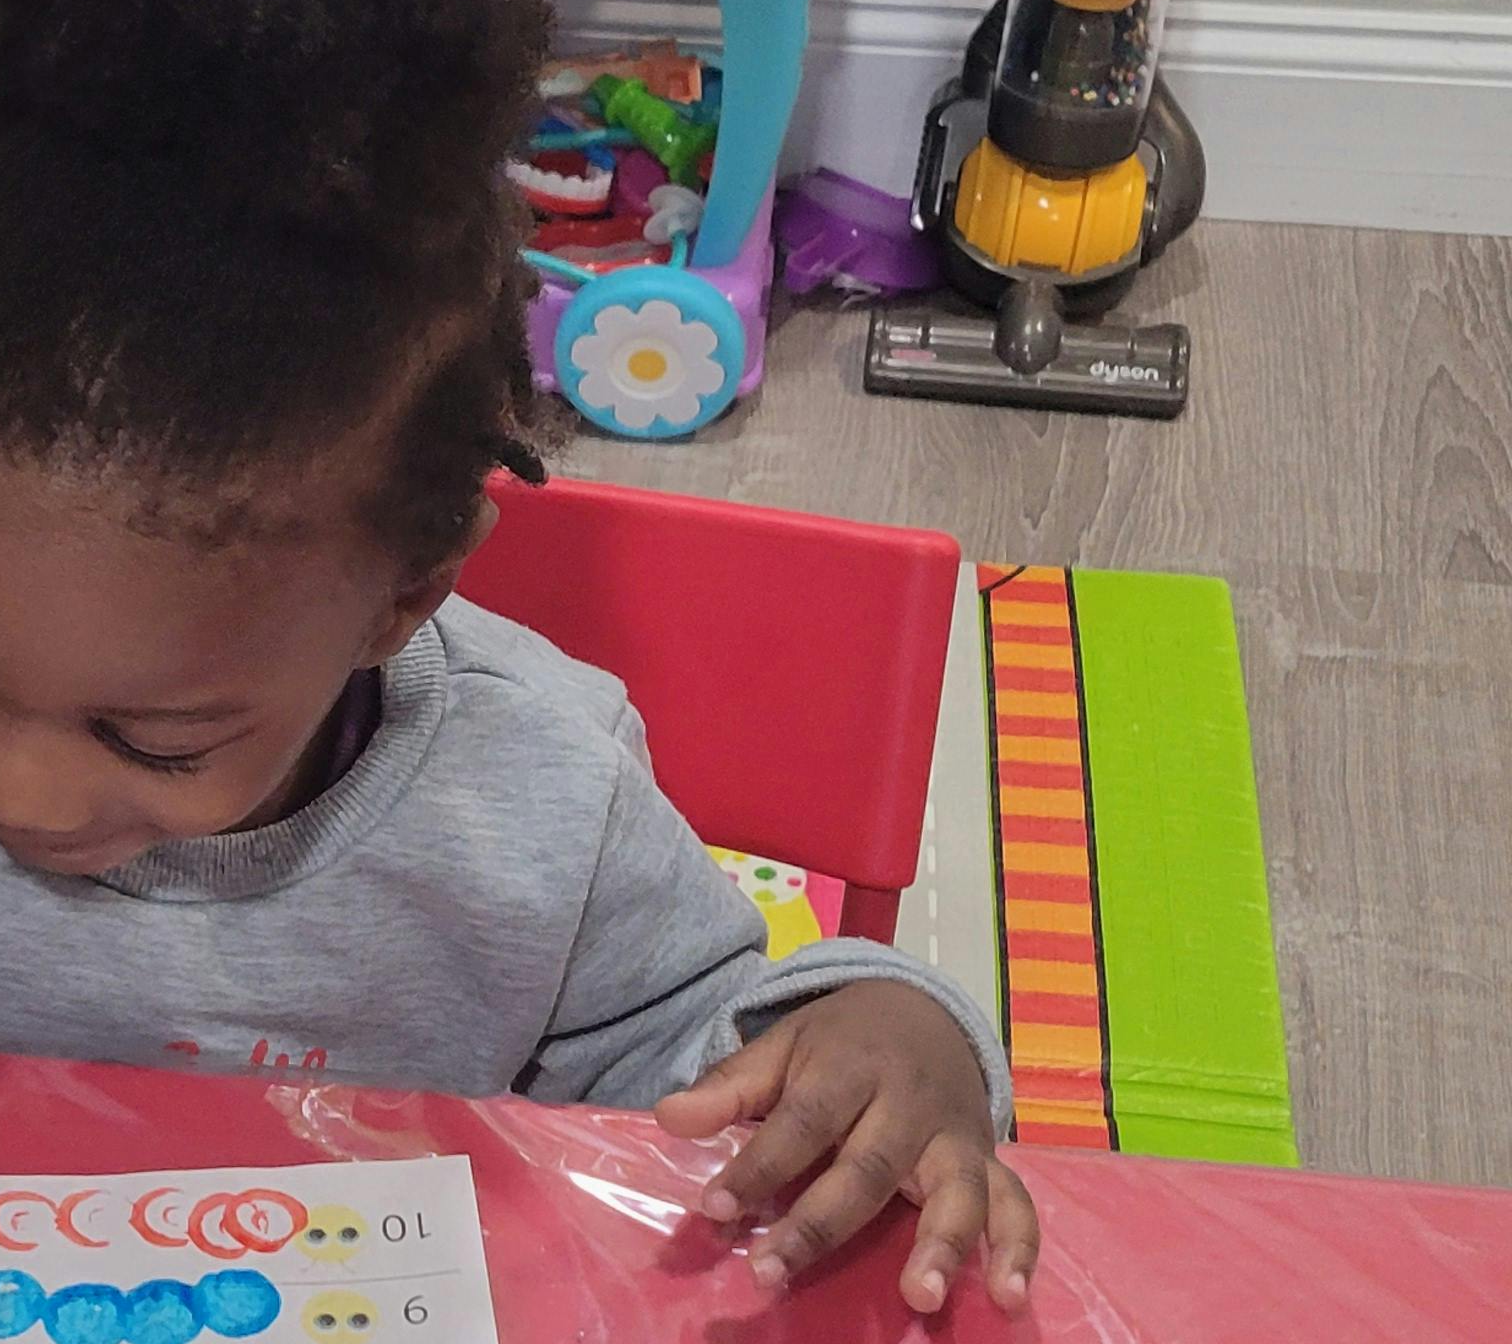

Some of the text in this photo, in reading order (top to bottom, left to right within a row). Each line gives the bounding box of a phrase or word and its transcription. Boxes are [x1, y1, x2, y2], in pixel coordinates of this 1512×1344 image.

[1089, 360, 1160, 385] dyson
[381, 1211, 432, 1243] 10
[402, 1294, 429, 1325] 9
